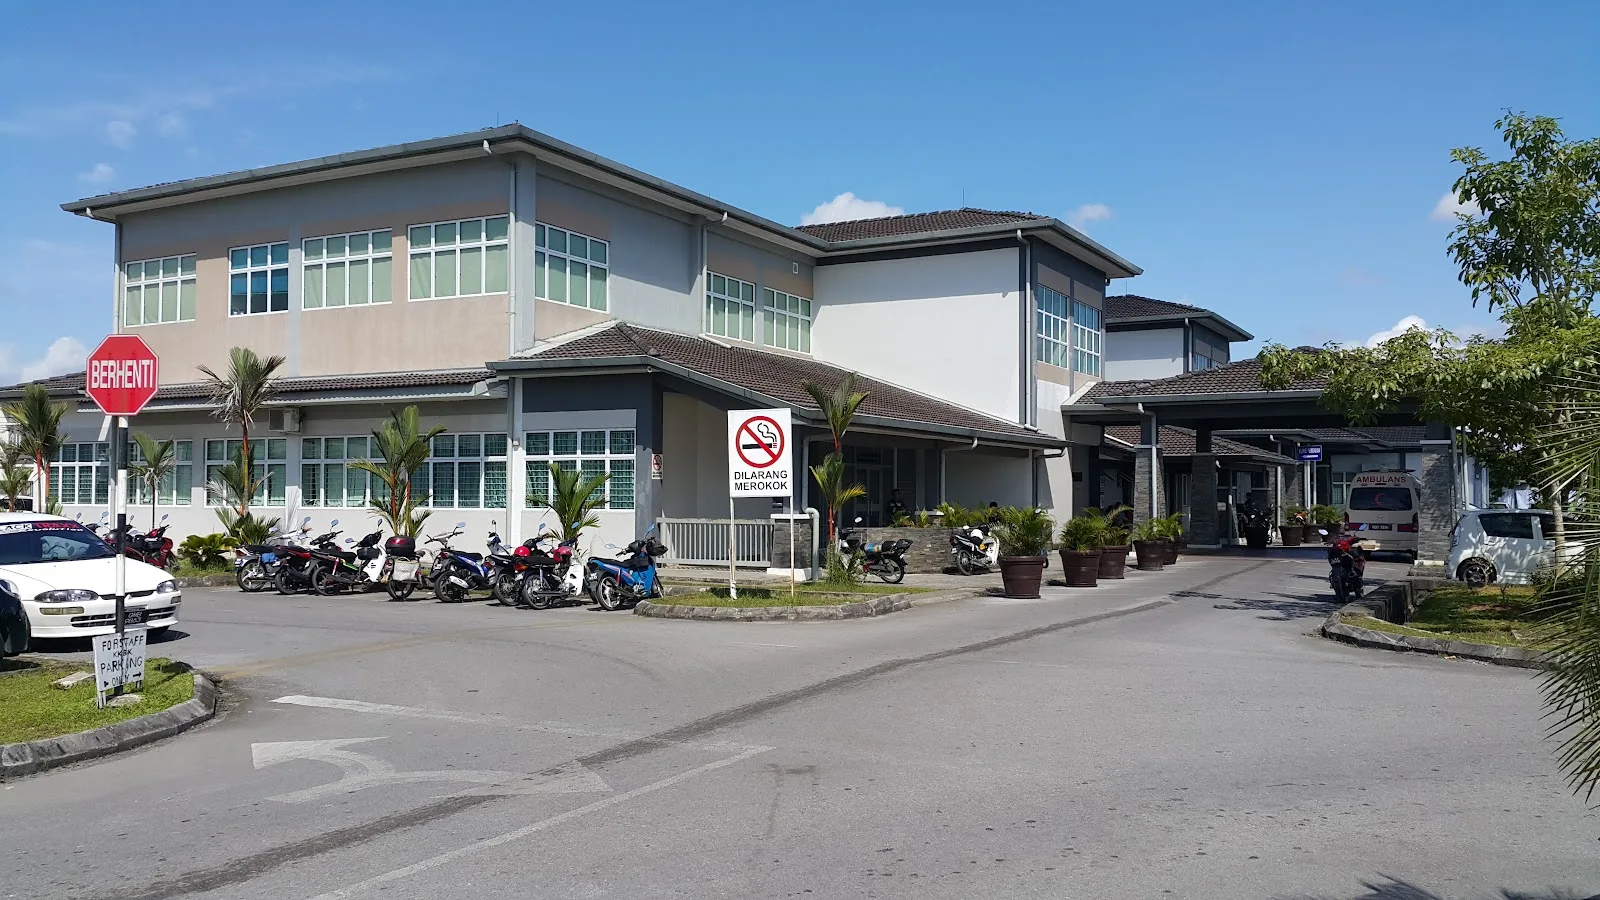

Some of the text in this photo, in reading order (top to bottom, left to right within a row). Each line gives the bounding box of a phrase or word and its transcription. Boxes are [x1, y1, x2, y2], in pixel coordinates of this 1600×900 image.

[91, 360, 153, 389] BERHENTI
[734, 470, 788, 480] DILARANG
[734, 481, 788, 491] MEROKOK
[101, 657, 143, 674] PARKING
[112, 675, 130, 687] ONLY
